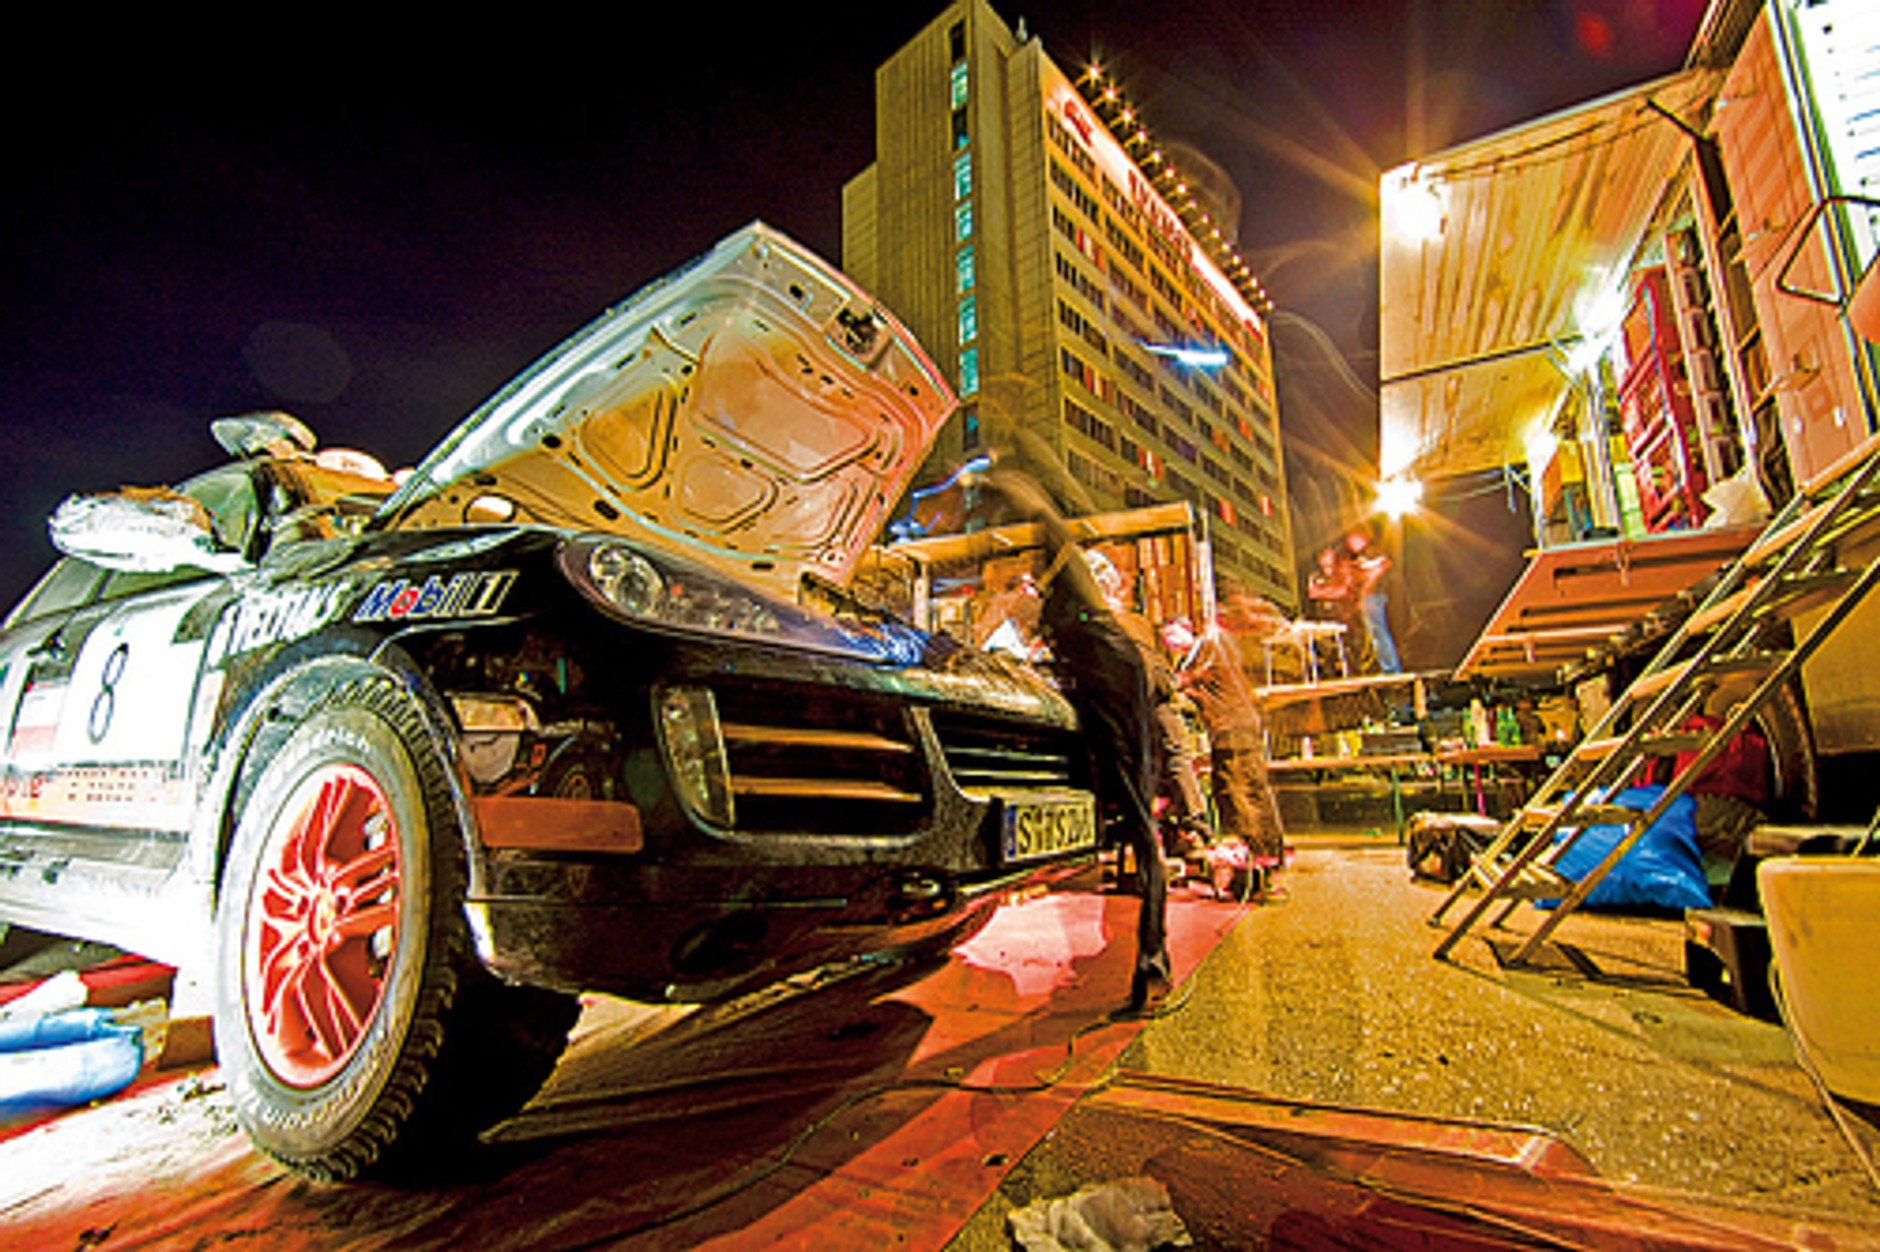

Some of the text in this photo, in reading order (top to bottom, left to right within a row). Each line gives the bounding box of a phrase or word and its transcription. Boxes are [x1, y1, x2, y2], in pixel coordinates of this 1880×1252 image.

[351, 571, 511, 622] Mobil 1
[87, 642, 129, 745] 8
